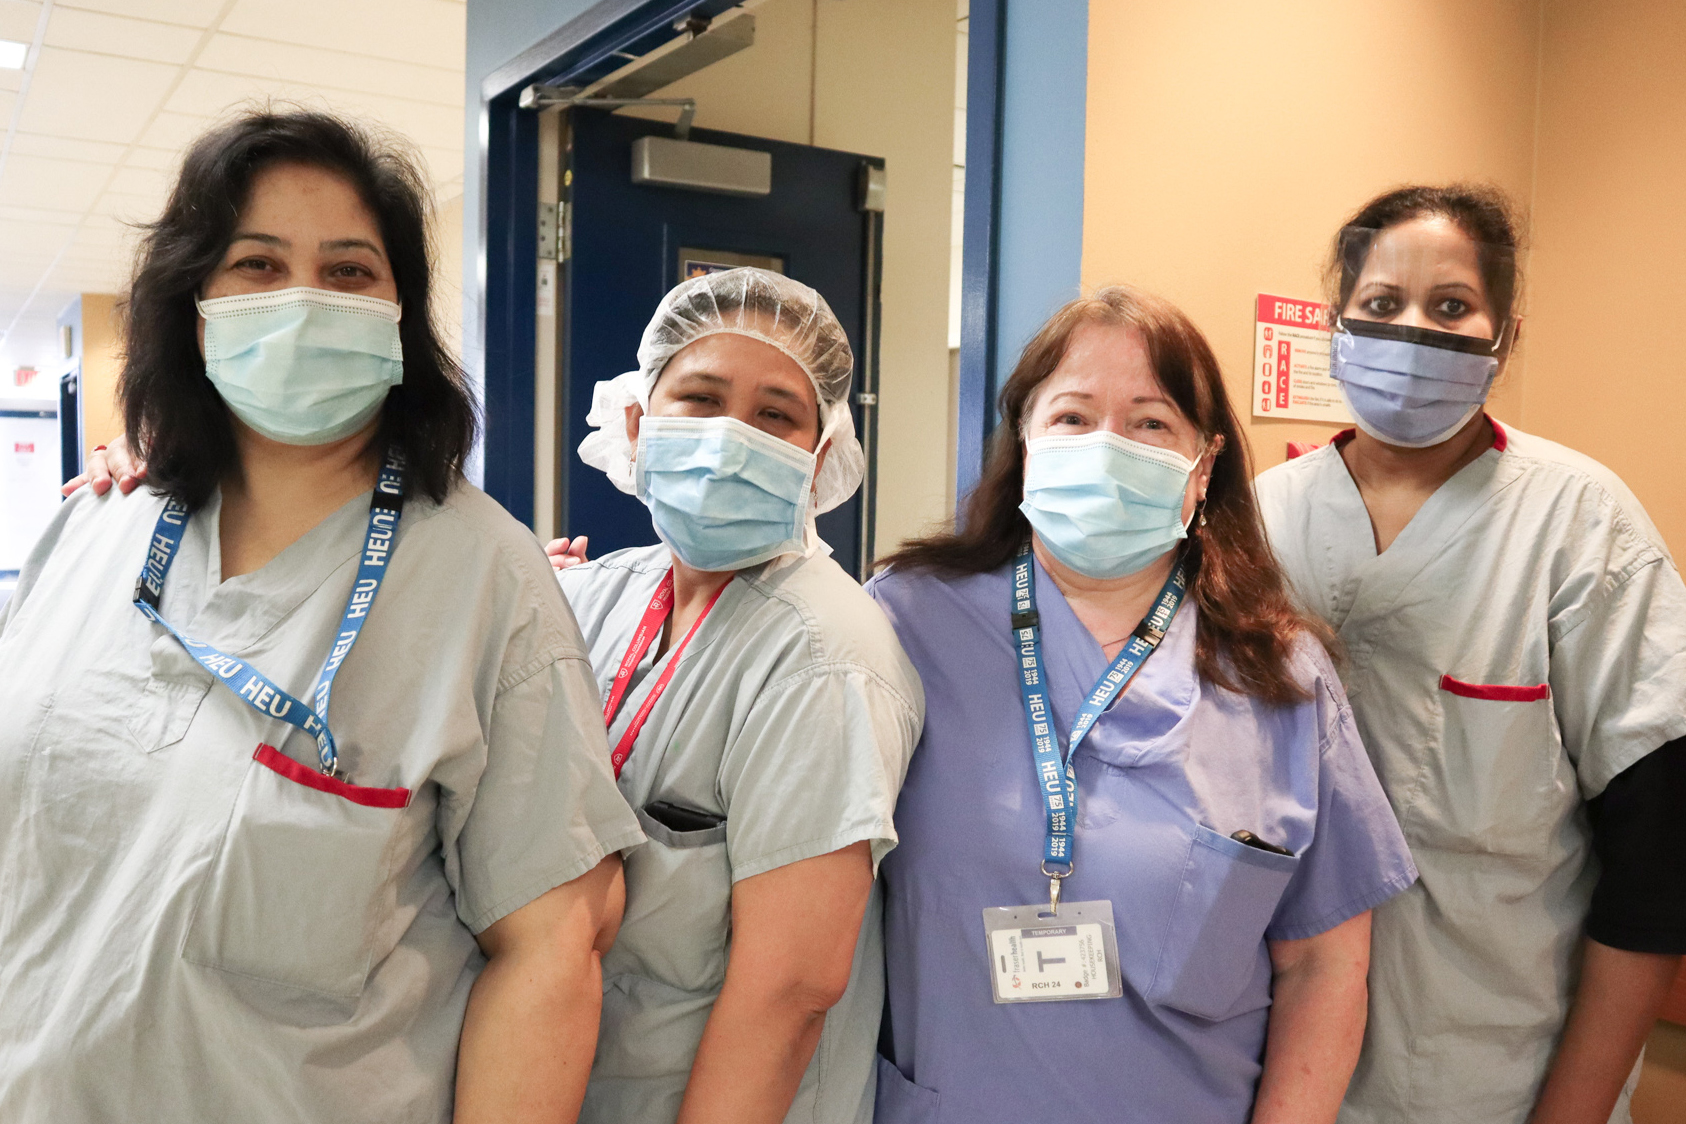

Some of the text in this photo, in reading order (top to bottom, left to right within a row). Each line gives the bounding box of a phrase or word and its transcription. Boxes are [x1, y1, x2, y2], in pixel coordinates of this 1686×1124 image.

[1275, 301, 1303, 322] FIRE
[364, 527, 392, 566] HEU
[1016, 563, 1028, 588] HEU
[347, 578, 377, 618] HEU
[1162, 592, 1173, 605] 1944
[1169, 596, 1178, 609] 2019
[325, 630, 357, 671] HEU
[1129, 636, 1148, 656] HE
[200, 653, 243, 678] HEU
[240, 675, 292, 717] HEU
[1089, 680, 1115, 706] HEU
[1028, 694, 1047, 722] HEU
[1041, 761, 1061, 793] HEU
[1058, 812, 1067, 831] 1944
[1051, 813, 1059, 831] 2019
[1050, 837, 1059, 857] 2019
[1031, 928, 1067, 936] TEMPORARY
[1037, 951, 1066, 973] T
